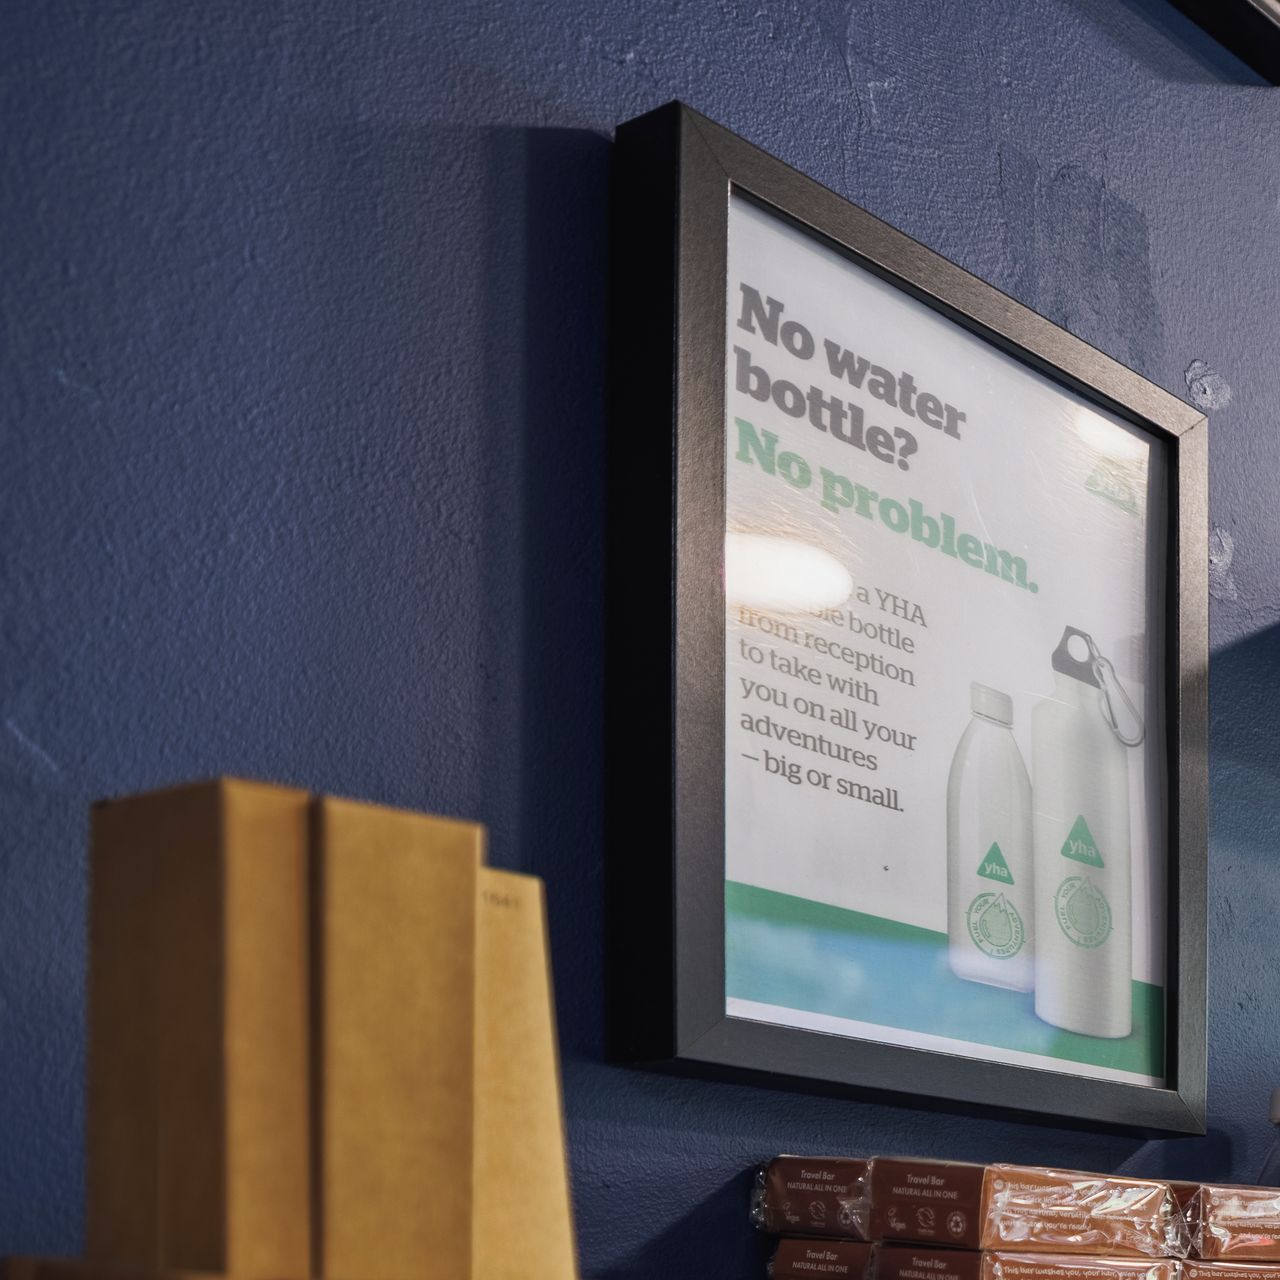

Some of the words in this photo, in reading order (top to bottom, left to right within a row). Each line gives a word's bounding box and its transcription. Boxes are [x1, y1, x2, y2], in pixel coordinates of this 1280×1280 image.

[736, 283, 815, 360] No
[824, 338, 966, 439] water
[733, 345, 918, 470] bottle?
[735, 418, 812, 490] No
[820, 465, 1039, 594] problem.
[856, 586, 870, 605] a
[875, 588, 927, 628] YHA
[738, 606, 803, 644] from
[804, 632, 916, 687] reception
[849, 610, 915, 654] bottle
[739, 638, 764, 664] to
[770, 649, 822, 685] take
[826, 673, 880, 706] with
[740, 677, 789, 709] you
[793, 696, 826, 721] on
[830, 708, 858, 733] all
[862, 719, 917, 751] your
[740, 712, 878, 771] adventures
[764, 749, 802, 785] big
[807, 767, 832, 790] or
[837, 777, 904, 812] small.
[984, 862, 1008, 877] yha
[1069, 840, 1096, 858] yha
[972, 920, 984, 944] FUEL
[801, 1170, 821, 1180] Travel
[823, 1172, 835, 1180] Bar
[893, 1187, 921, 1196] NATURAL
[922, 1188, 933, 1196] ALL
[934, 1190, 941, 1198] IN
[943, 1191, 958, 1199] ONE
[907, 1174, 929, 1185] Travel
[932, 1177, 944, 1186] Bar
[792, 1261, 816, 1270] NATURAL
[806, 1250, 825, 1259] Travel
[826, 1252, 838, 1260] Bar
